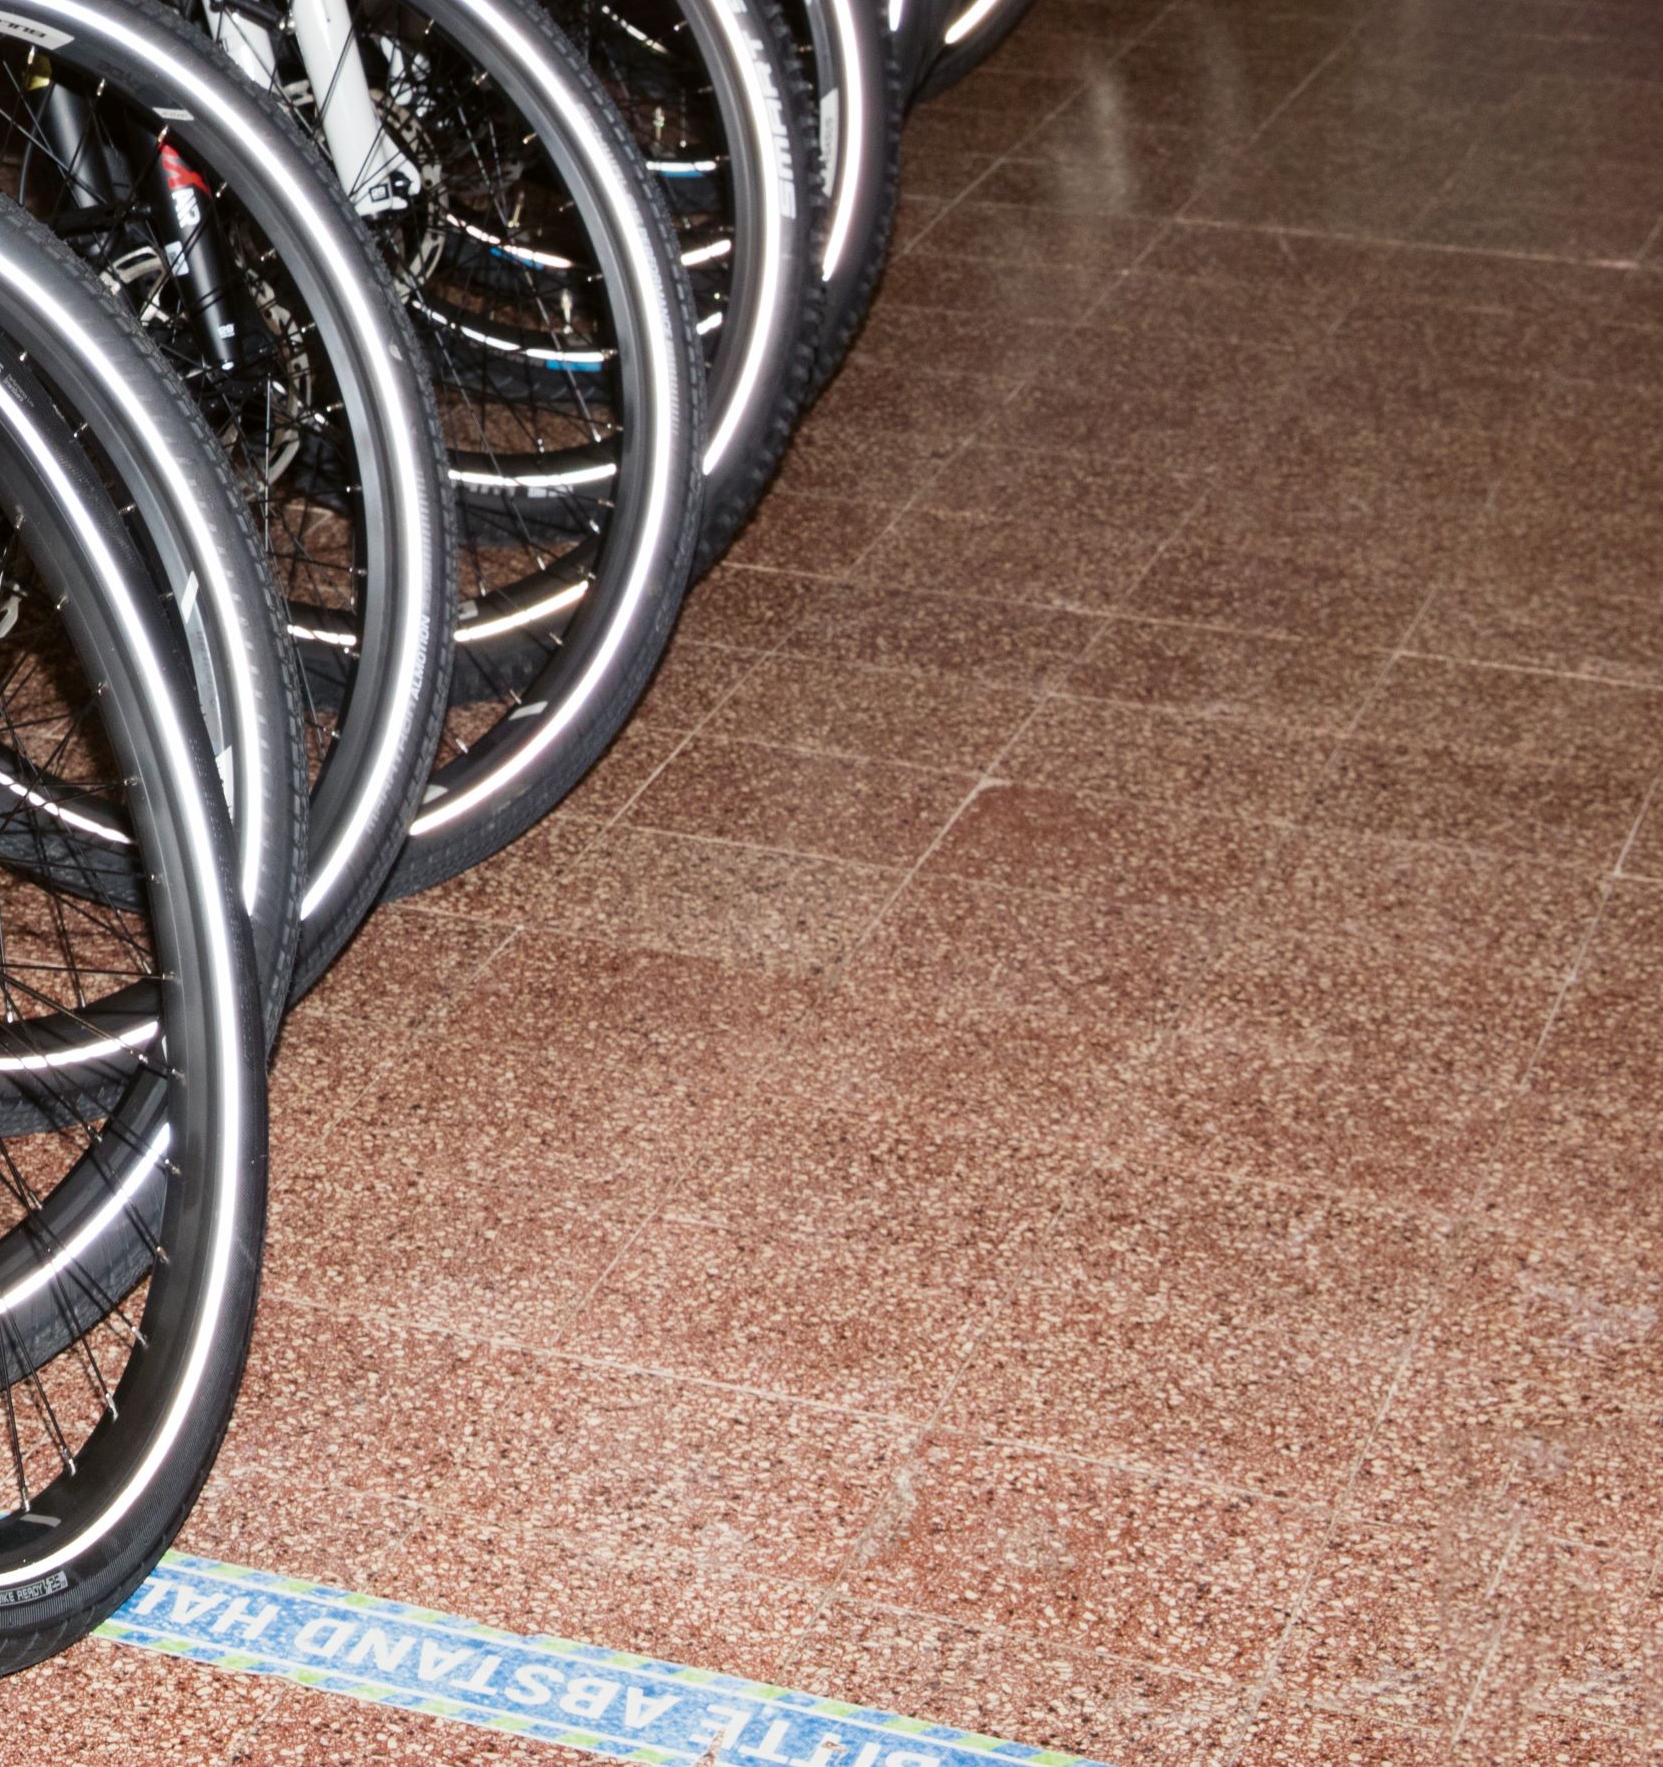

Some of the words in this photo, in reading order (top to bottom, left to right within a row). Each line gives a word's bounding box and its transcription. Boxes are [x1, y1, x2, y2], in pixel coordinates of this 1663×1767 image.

[15, 1583, 46, 1601] READY
[128, 1577, 280, 1640] HAL
[293, 1613, 684, 1726] ABSTAND
